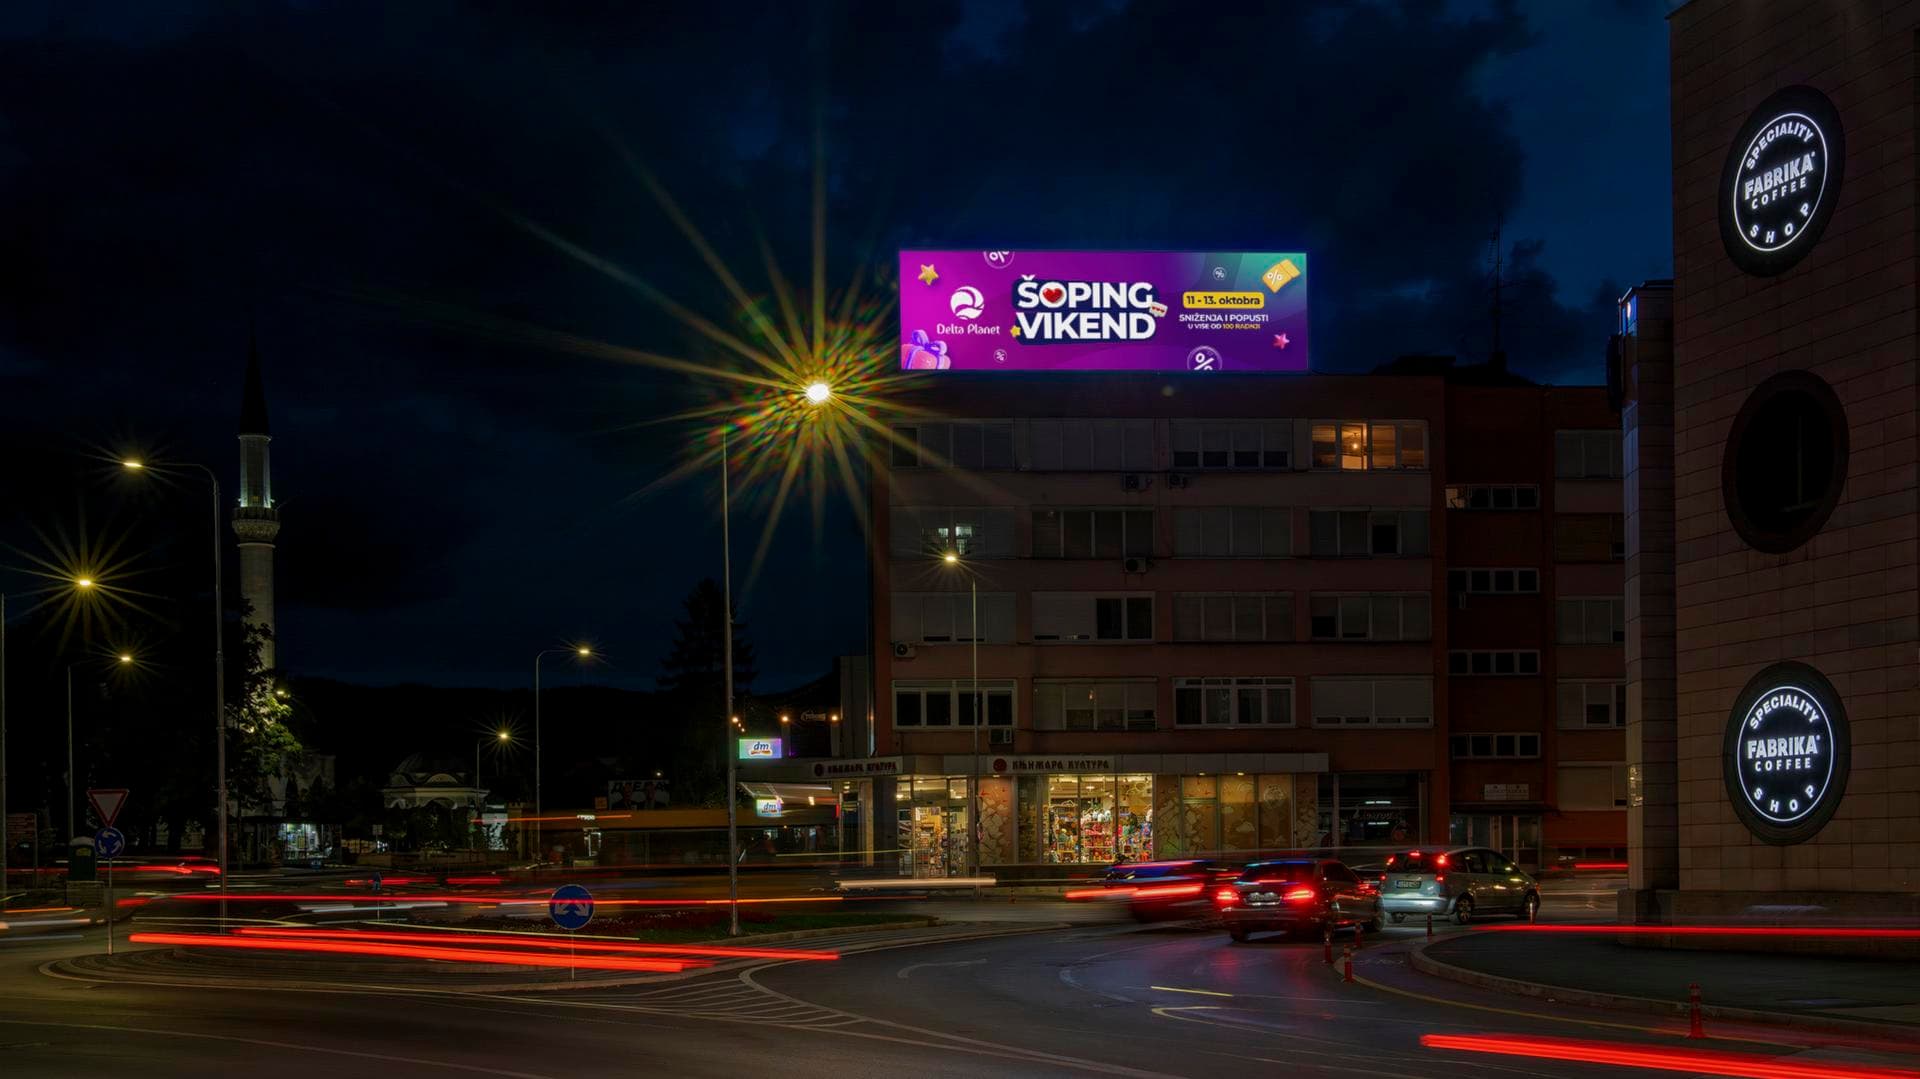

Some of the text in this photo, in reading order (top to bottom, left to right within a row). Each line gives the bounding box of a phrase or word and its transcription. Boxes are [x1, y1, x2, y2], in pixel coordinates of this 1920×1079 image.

[1746, 121, 1814, 170] SPECIALITY
[1744, 154, 1814, 200] FABRIKA
[1751, 176, 1807, 210] COFFEE
[1750, 202, 1810, 244] SHOP
[1017, 274, 1153, 309] ŠOPING
[1186, 295, 1195, 305] 11
[1204, 295, 1217, 305] 13.
[1219, 295, 1261, 305] oktobra
[936, 323, 1001, 335] Delta Planet
[1016, 312, 1156, 339] VIKEND
[1179, 312, 1224, 322] SNIŽENJA
[1229, 314, 1269, 322] POPUSTI
[1750, 694, 1820, 730] SPECIALITY
[753, 741, 770, 751] dm
[1747, 735, 1821, 759] FABRIKA
[1755, 757, 1812, 772] COFFEE
[1753, 785, 1815, 812] SHOP
